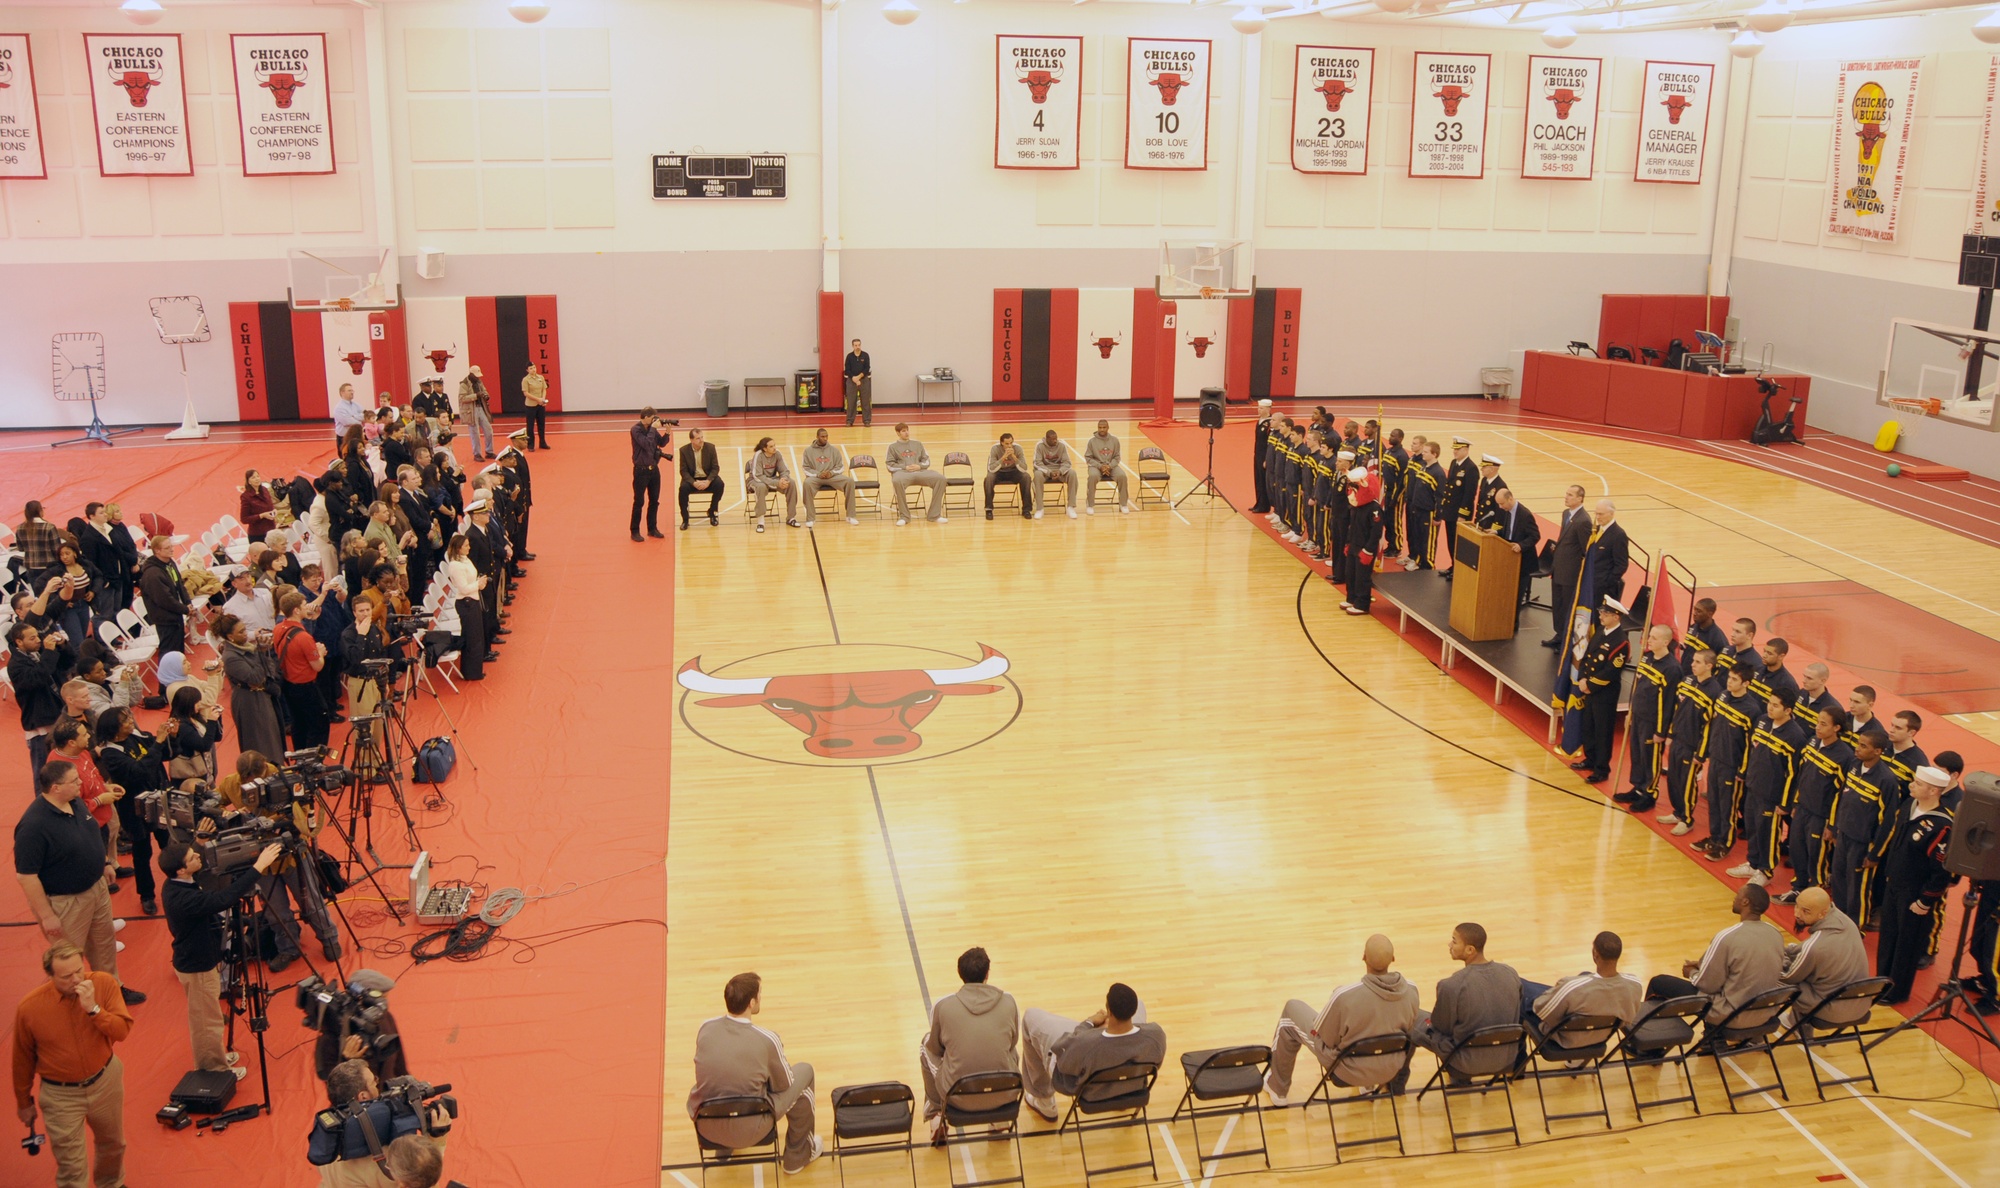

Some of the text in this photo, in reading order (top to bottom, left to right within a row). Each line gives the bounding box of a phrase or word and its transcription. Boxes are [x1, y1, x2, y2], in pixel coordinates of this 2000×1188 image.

[102, 47, 164, 58] CHICAGO
[250, 49, 309, 60] CHICAGO
[1012, 48, 1066, 58] CHICAGO
[1144, 50, 1196, 61] CHICAGO
[114, 59, 156, 70] BULLS
[260, 60, 302, 71] BULLS
[1021, 58, 1058, 69] BULLS
[1152, 62, 1188, 72] BULLS
[1310, 58, 1360, 68] CHICAGO
[1318, 68, 1352, 78] BULLS
[1428, 64, 1476, 74] CHICAGO
[1542, 67, 1588, 78] CHICAGO
[1436, 74, 1469, 84] BULLS
[1549, 78, 1582, 88] BULLS
[1658, 73, 1700, 84] CHICAGO
[1663, 84, 1694, 94] BULLS
[1855, 97, 1894, 109] CHICAGO
[116, 112, 166, 122] EASTERN
[260, 112, 310, 122] EASTERN
[1860, 110, 1887, 121] BULLS
[1033, 110, 1045, 132] 4
[1155, 112, 1180, 134] 10
[106, 125, 179, 136] CONFERENCE
[250, 124, 322, 135] CONFERENCE
[1317, 118, 1346, 138] 23
[1434, 122, 1463, 142] 33
[1533, 124, 1586, 141] COACH
[1648, 129, 1697, 142] GENERAL
[112, 138, 175, 148] CHAMPIONS
[256, 138, 319, 148] CHAMPIONS
[1016, 138, 1060, 146] JERRY SLOAN
[1146, 138, 1188, 147] BOB LOVE
[1296, 138, 1365, 150] MICHAEL JORDAN
[1533, 142, 1586, 152] PHIL JACKSON
[1418, 143, 1478, 153] SCOTTIE PIPPEN
[1646, 142, 1698, 154] MANAGER
[125, 152, 166, 162] 1996-97
[268, 151, 312, 161] 1997-98
[1148, 151, 1186, 160] 1968-1976
[1313, 150, 1348, 158] 1984-1993
[1430, 154, 1464, 162] 1987-1998
[1540, 153, 1578, 162] 1989-1998
[658, 158, 785, 166] HOME VISITOR
[1312, 159, 1347, 168] 1995-1998
[1429, 162, 1464, 170] 2003-2004
[1645, 158, 1695, 168] JERRY KRAUSE
[1542, 163, 1574, 172] 545-193
[1858, 164, 1874, 174] 1991
[1166, 316, 1174, 327] 4
[374, 325, 382, 338] 3
[1002, 308, 1013, 382] CHICAGO
[1281, 310, 1292, 376] BULLS
[240, 322, 256, 400] CHICAGO
